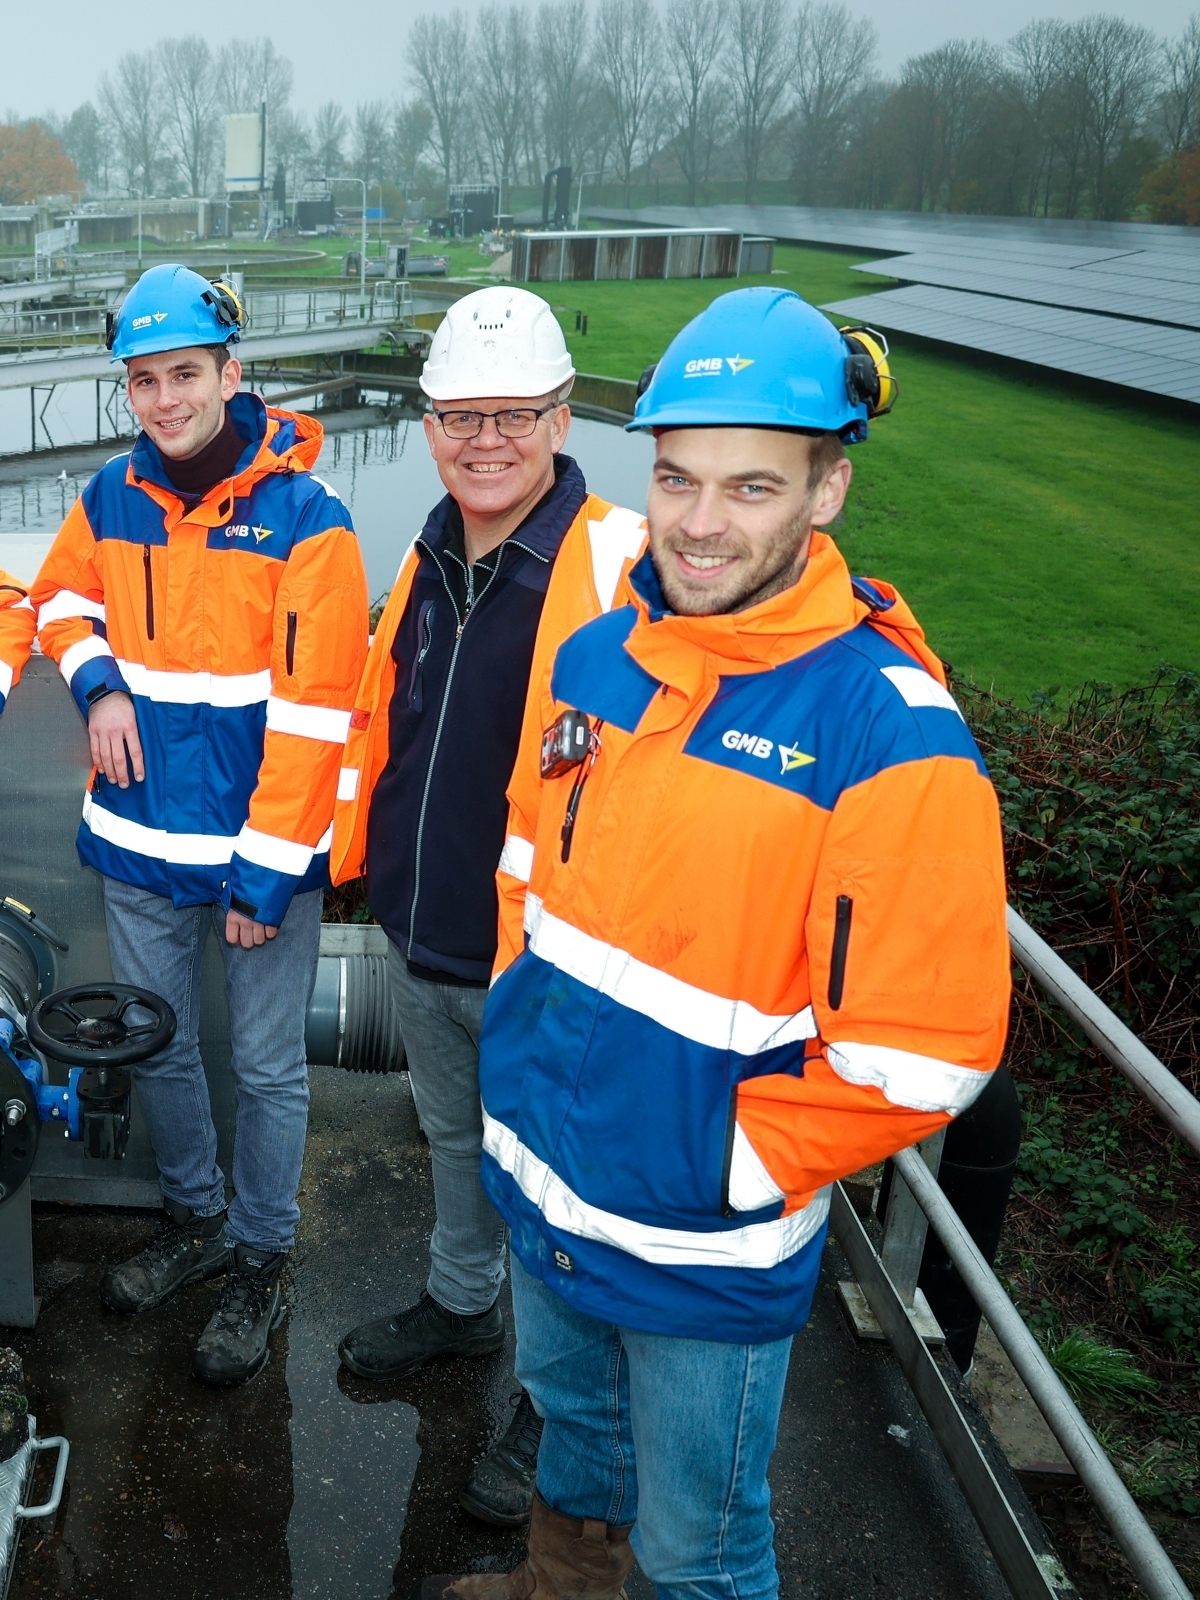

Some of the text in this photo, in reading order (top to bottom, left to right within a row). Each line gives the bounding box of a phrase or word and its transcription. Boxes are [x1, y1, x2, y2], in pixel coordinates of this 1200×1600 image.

[132, 315, 152, 327] GMB
[685, 358, 723, 372] GMB
[224, 525, 249, 538] GMB
[722, 730, 773, 758] GMB
